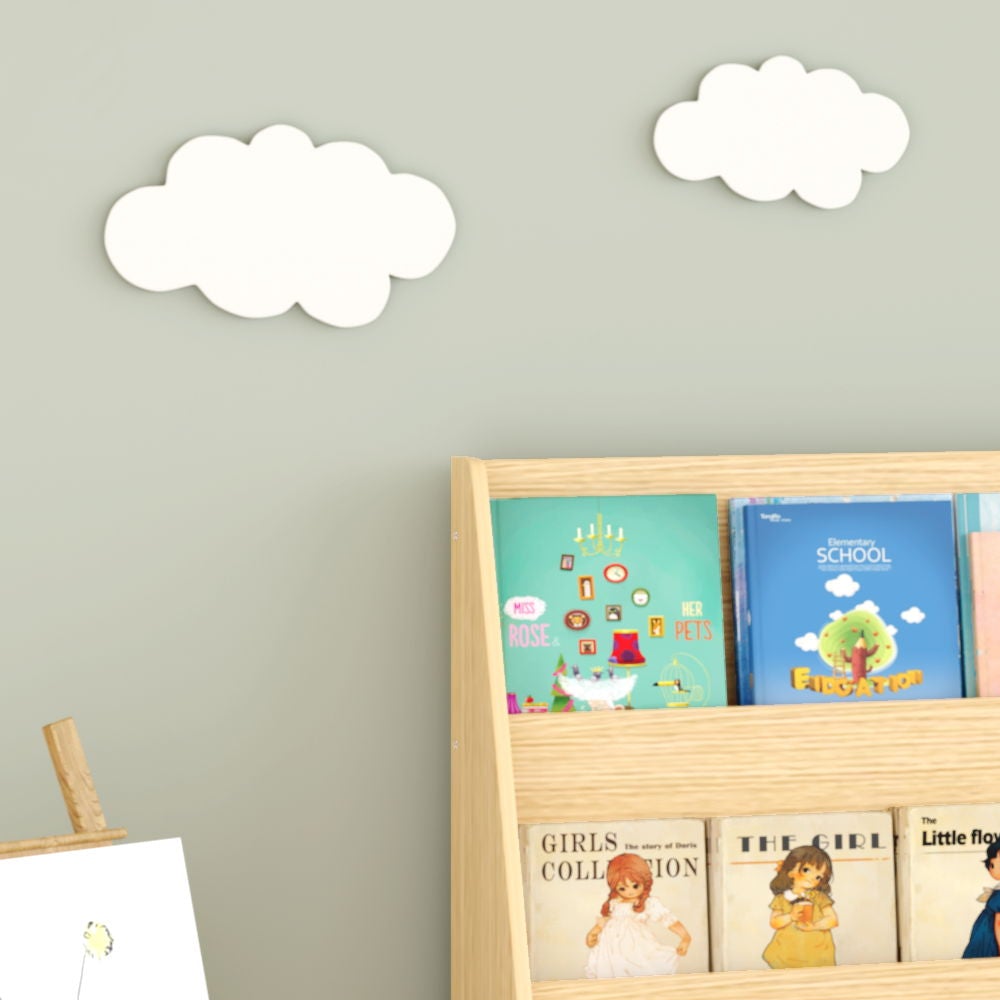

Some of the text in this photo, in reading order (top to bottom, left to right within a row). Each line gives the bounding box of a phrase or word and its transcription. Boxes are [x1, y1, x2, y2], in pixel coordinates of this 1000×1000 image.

[828, 537, 876, 547] Elementary
[816, 547, 892, 563] SCHOOL
[513, 602, 535, 614] MISS
[681, 601, 703, 616] HER
[509, 623, 550, 647] ROSE
[675, 620, 713, 640] PETS
[921, 817, 937, 825] The
[541, 832, 618, 854] GIRLS
[922, 830, 967, 846] Little
